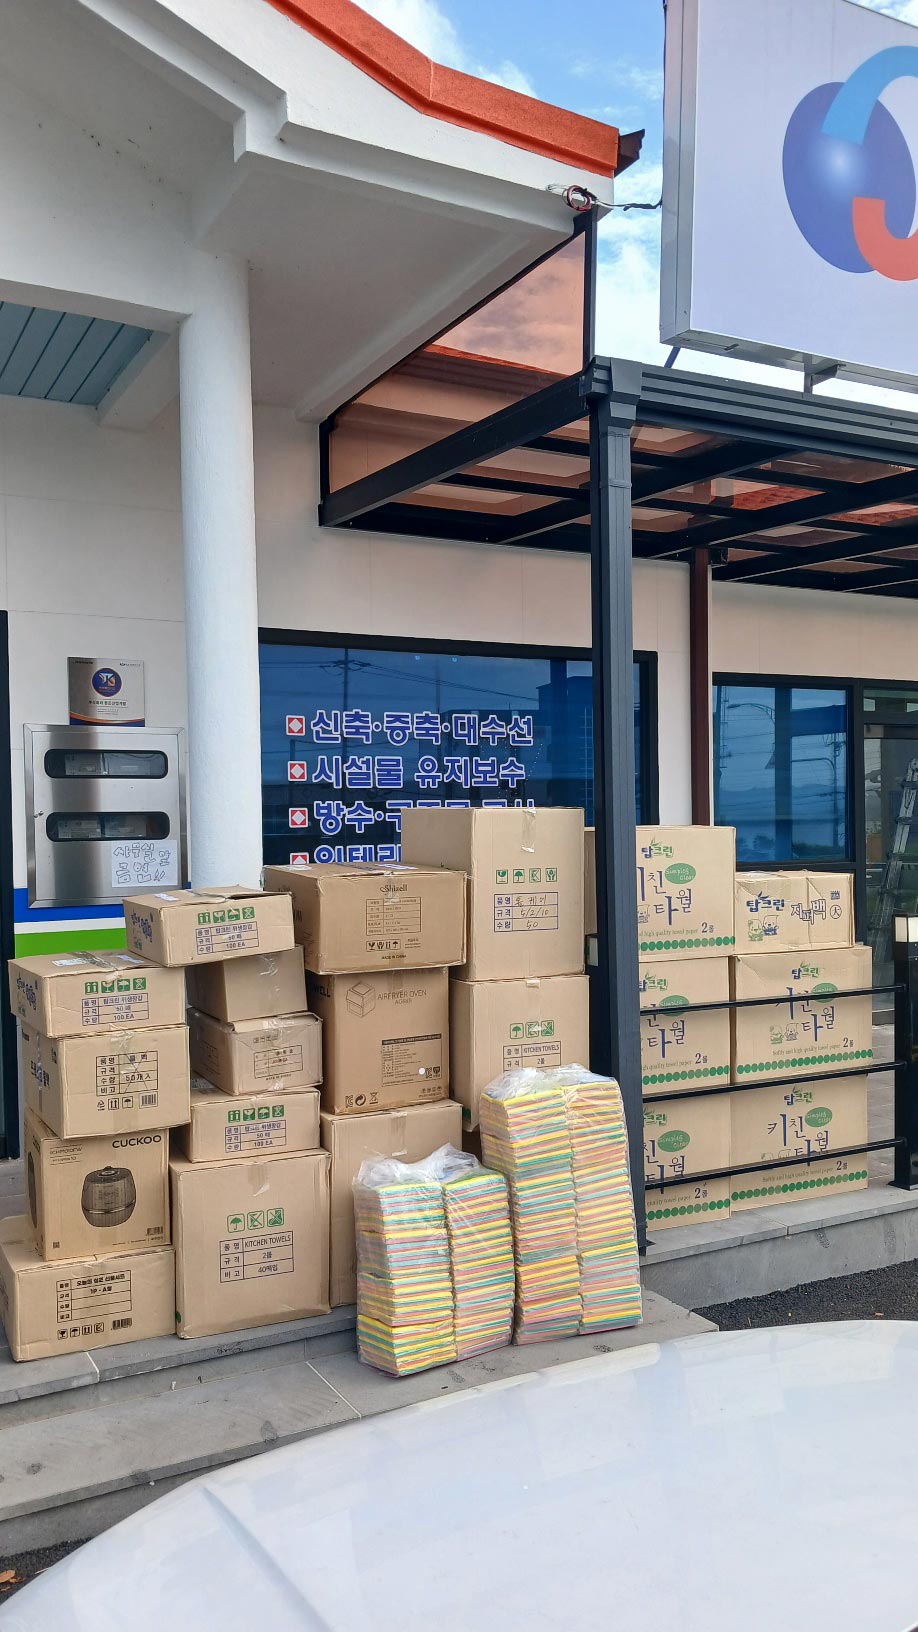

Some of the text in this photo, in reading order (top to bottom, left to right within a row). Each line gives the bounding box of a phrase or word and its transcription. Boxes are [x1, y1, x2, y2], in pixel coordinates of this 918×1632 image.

[312, 755, 526, 788] 시설물 유지보수
[113, 842, 156, 863] 사무실
[641, 844, 673, 858] 탑크린
[653, 888, 692, 925] 타월
[746, 898, 785, 912] 탑크린
[791, 968, 819, 979] 탑크린
[378, 989, 427, 1000] AIRFRYER OVEN
[801, 1005, 834, 1042] 타월
[647, 1020, 685, 1059] 타월
[542, 1044, 559, 1052] TOWELS
[101, 1076, 116, 1084] 수량
[784, 1093, 812, 1106] 탑크린
[767, 1114, 806, 1147] 키친
[112, 1135, 162, 1149] CUCKOO
[245, 1235, 291, 1248] KITCHEN TOWELS
